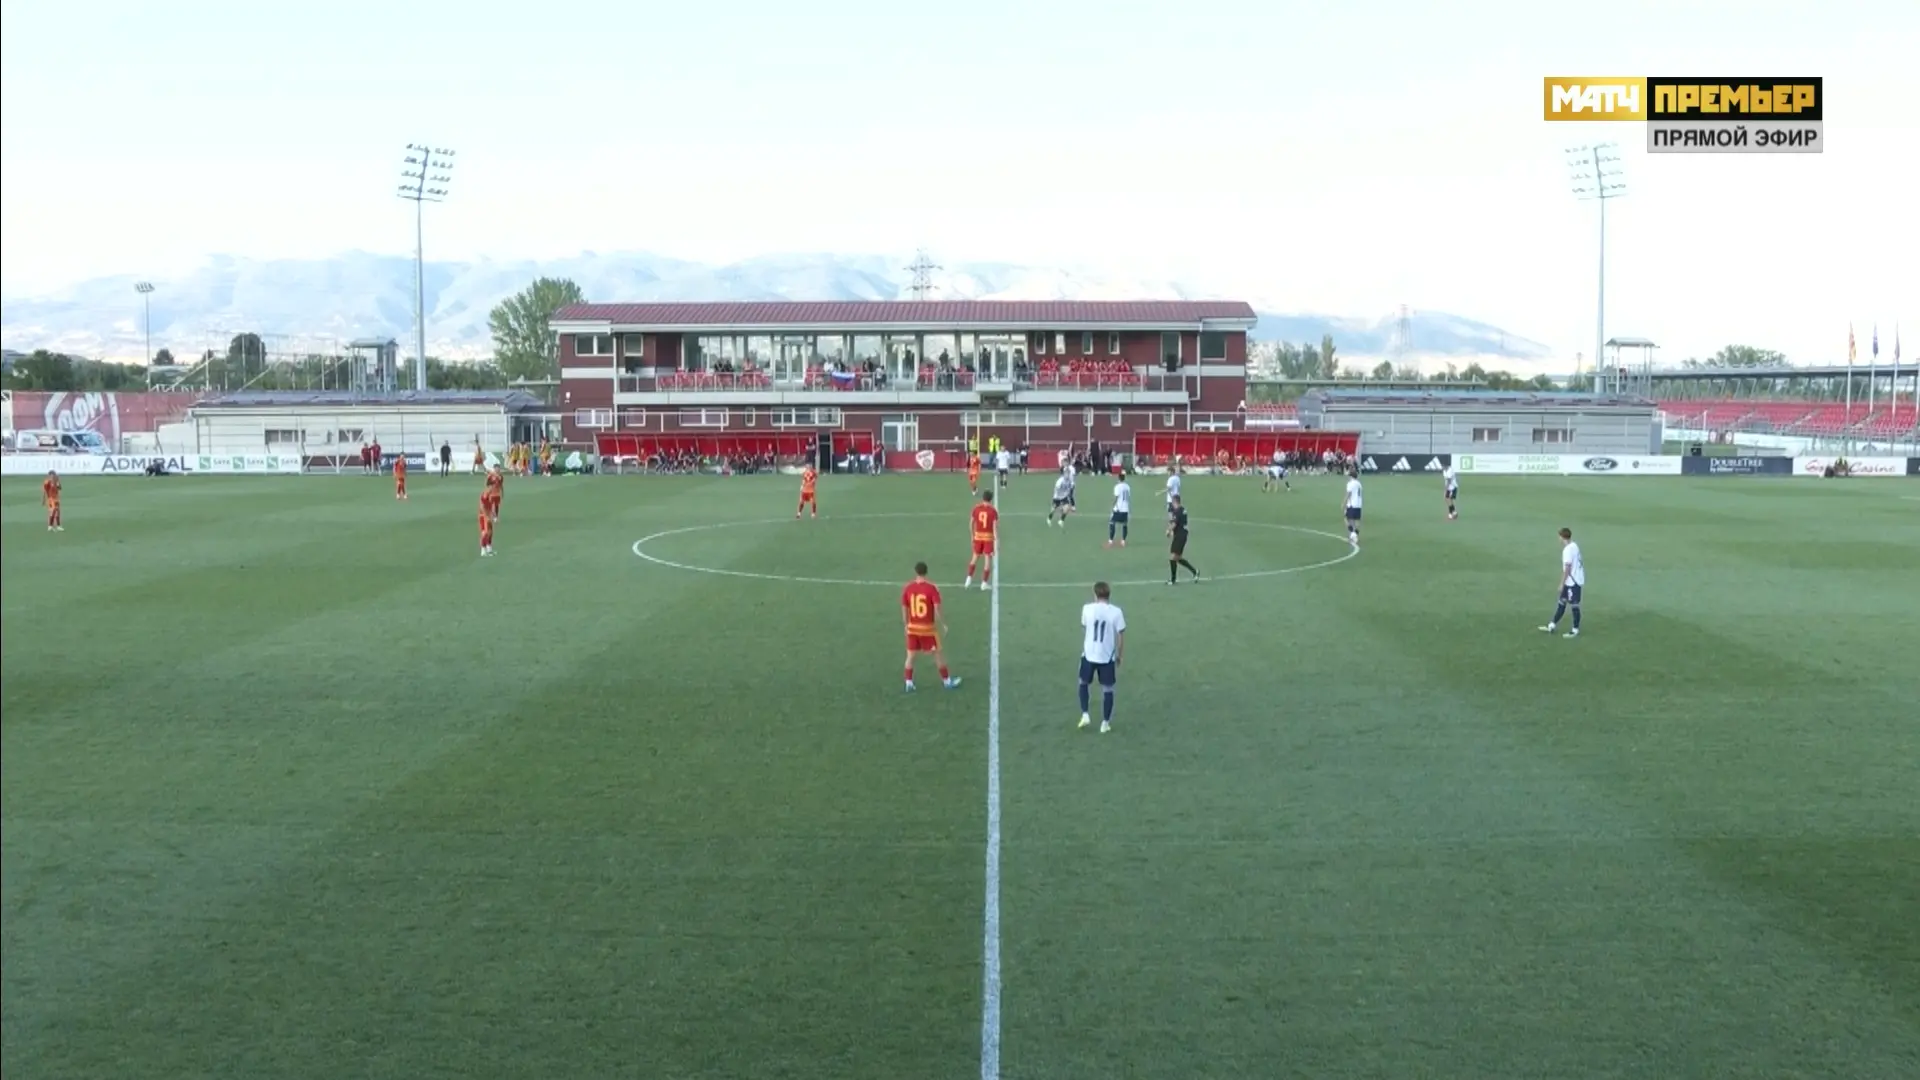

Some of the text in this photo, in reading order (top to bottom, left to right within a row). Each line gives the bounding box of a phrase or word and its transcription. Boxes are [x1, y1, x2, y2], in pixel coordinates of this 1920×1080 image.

[1590, 459, 1612, 469] Ford
[978, 511, 988, 528] 9
[910, 593, 928, 618] 16
[1093, 619, 1107, 643] 11
